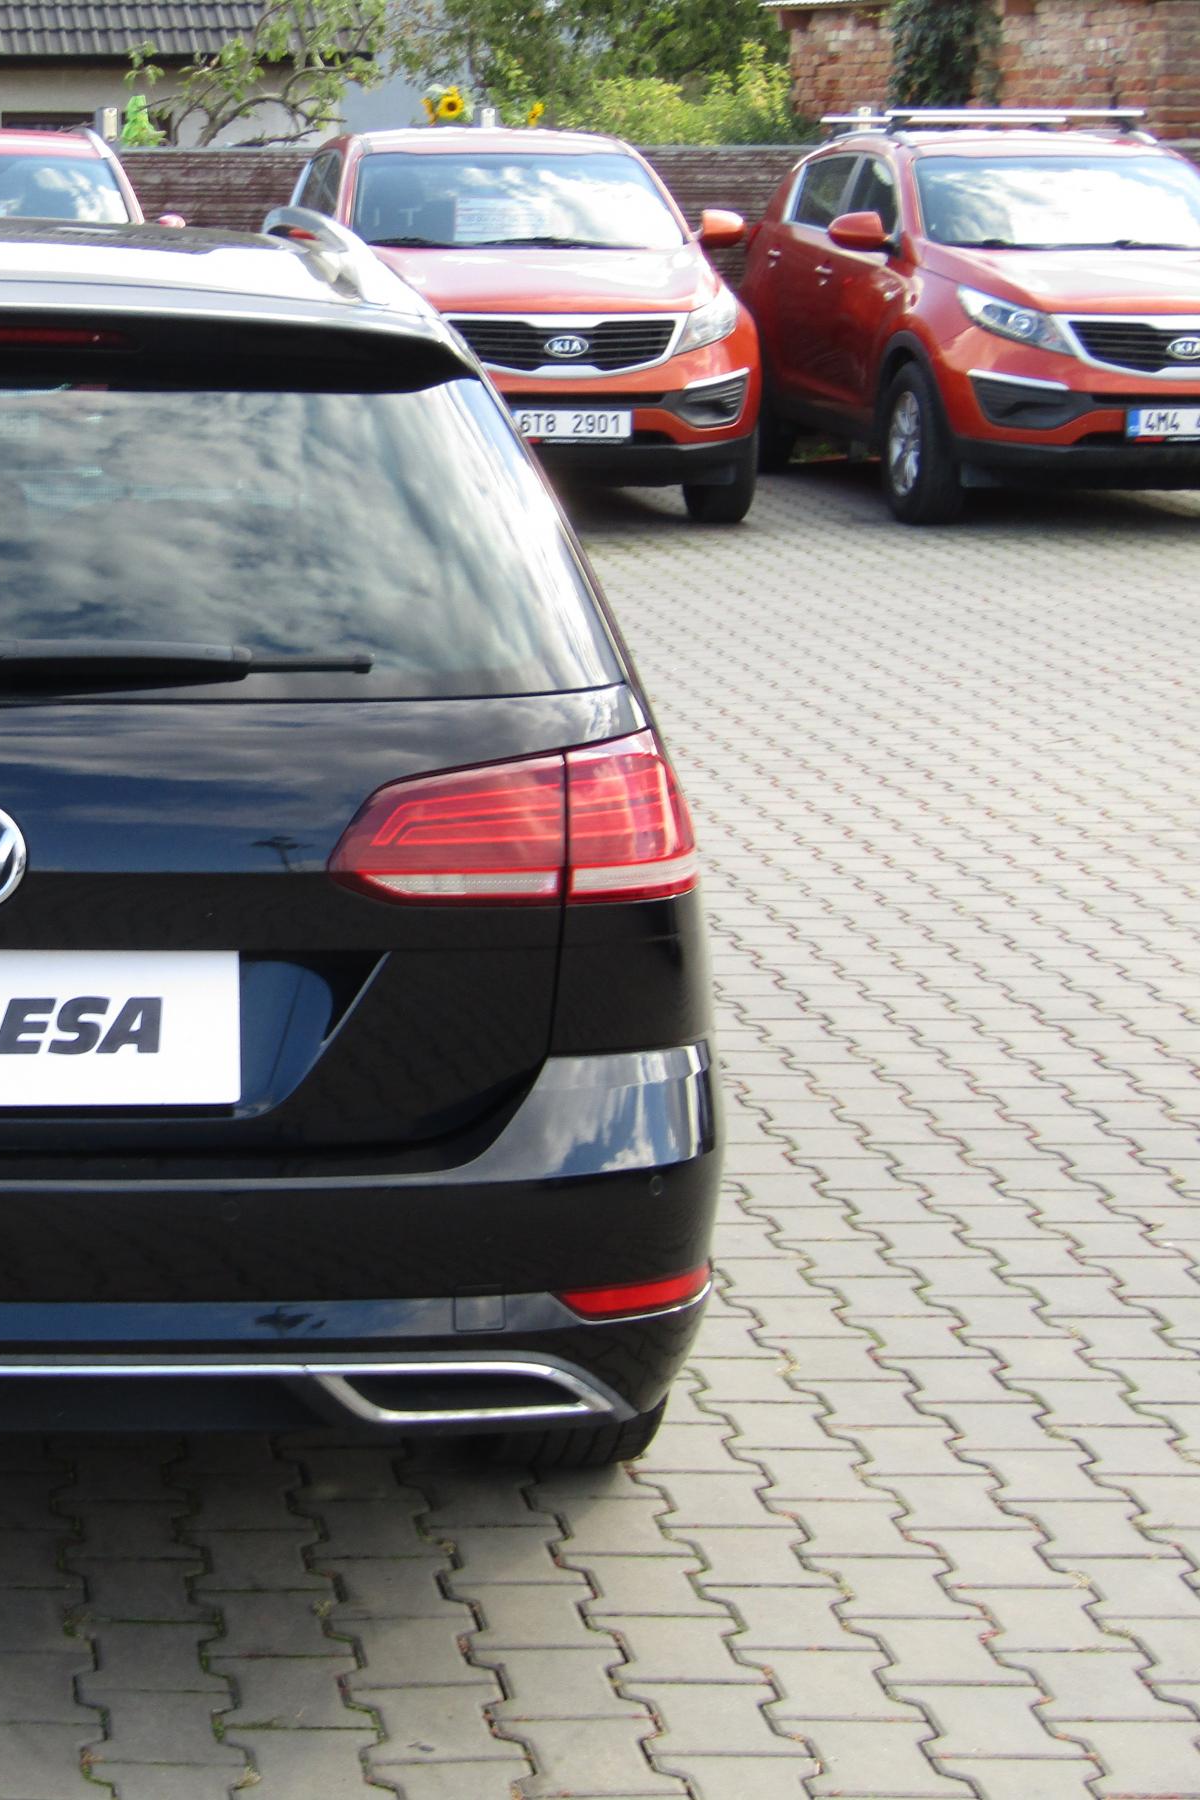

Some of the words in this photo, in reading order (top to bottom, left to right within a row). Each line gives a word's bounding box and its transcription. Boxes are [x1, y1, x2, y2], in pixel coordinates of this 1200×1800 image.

[552, 341, 582, 352] KIA
[521, 413, 557, 433] 6T8
[571, 413, 620, 434] 2901
[1145, 412, 1180, 433] 4M4
